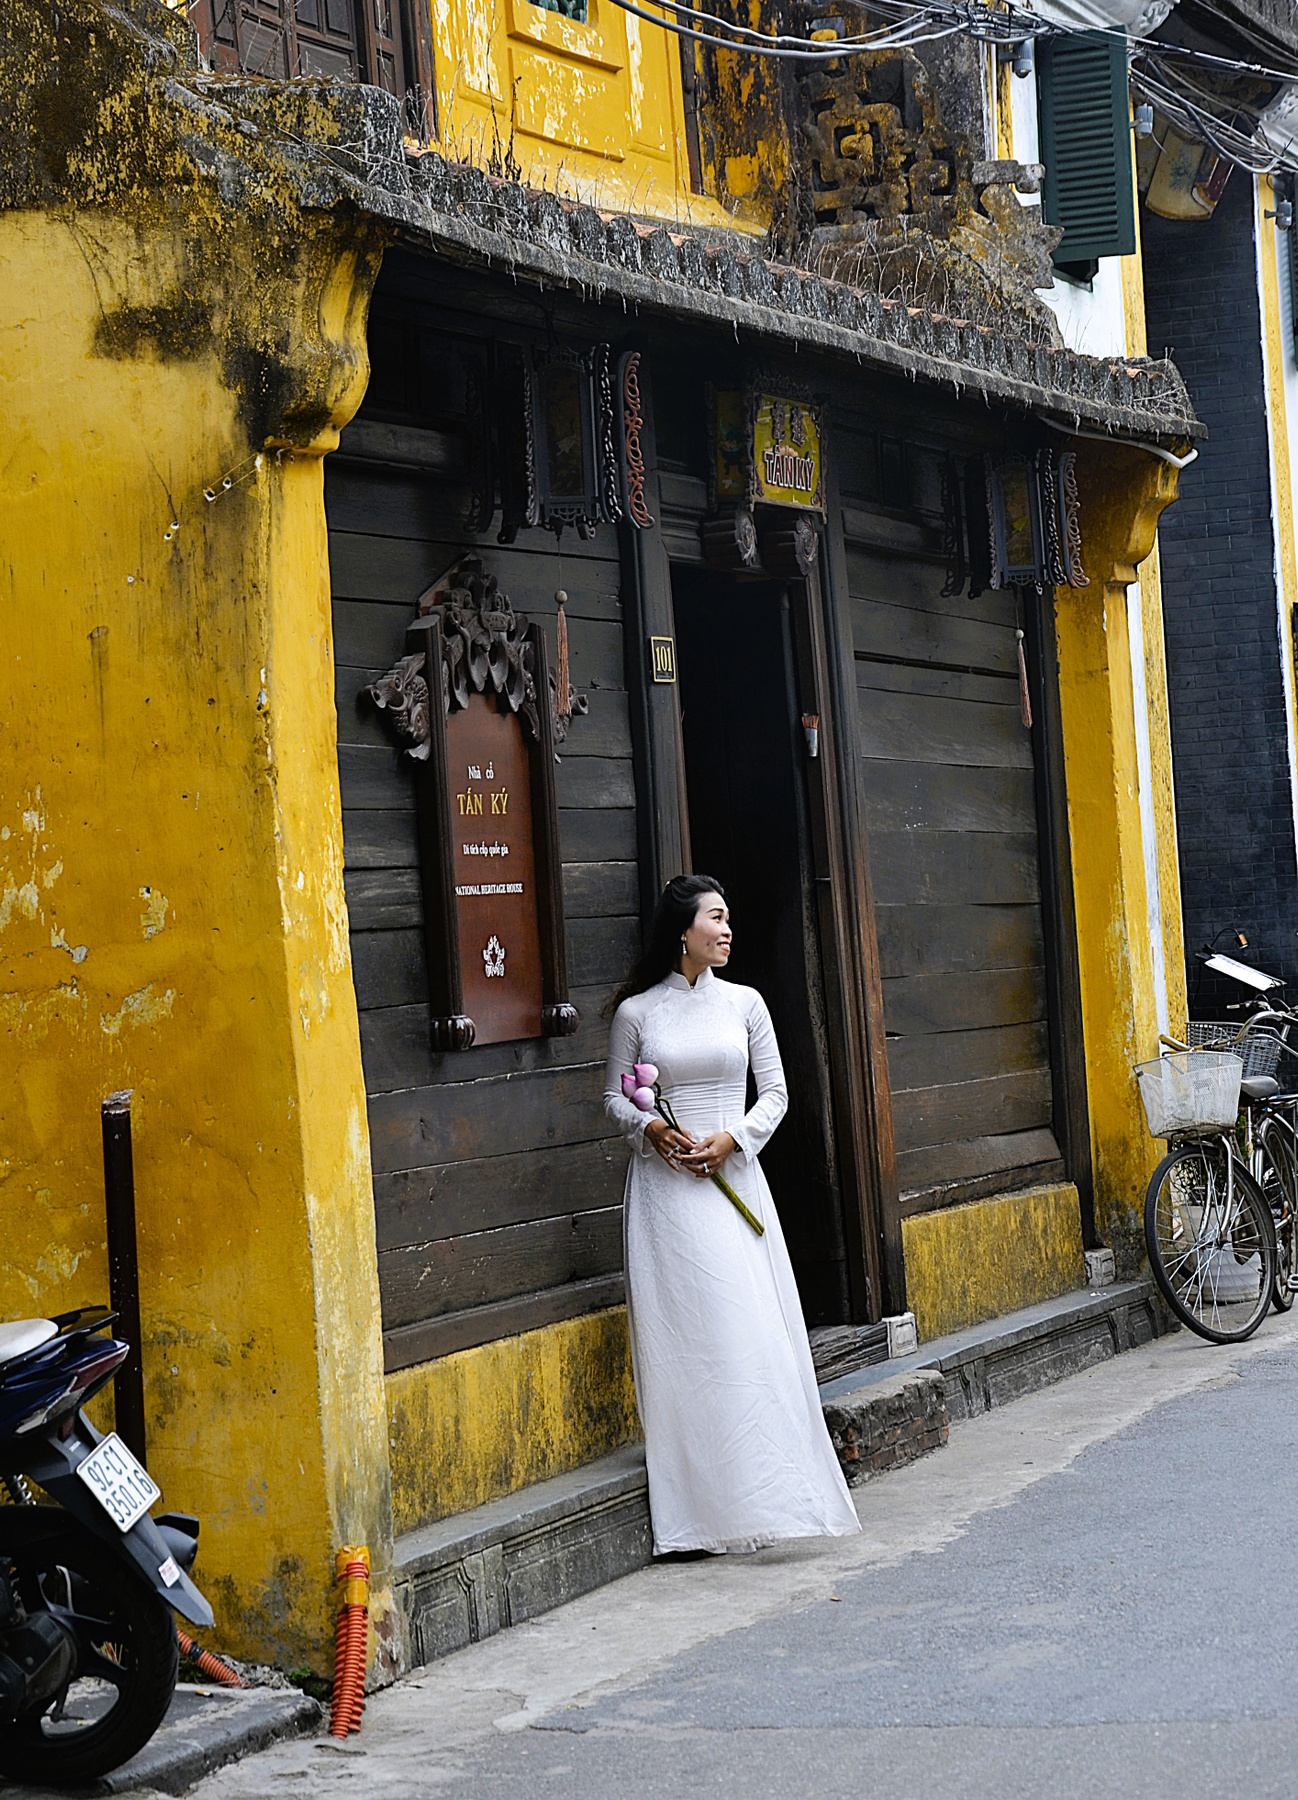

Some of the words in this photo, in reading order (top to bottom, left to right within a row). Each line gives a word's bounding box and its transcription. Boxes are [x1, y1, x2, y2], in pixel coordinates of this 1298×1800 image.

[796, 452, 815, 491] KÝ
[655, 646, 673, 672] 101
[456, 787, 483, 816] TẤN
[490, 787, 509, 815] KÝ
[481, 884, 506, 895] HERITAGE
[506, 882, 523, 893] HOUSE
[105, 1469, 153, 1524] 350.16
